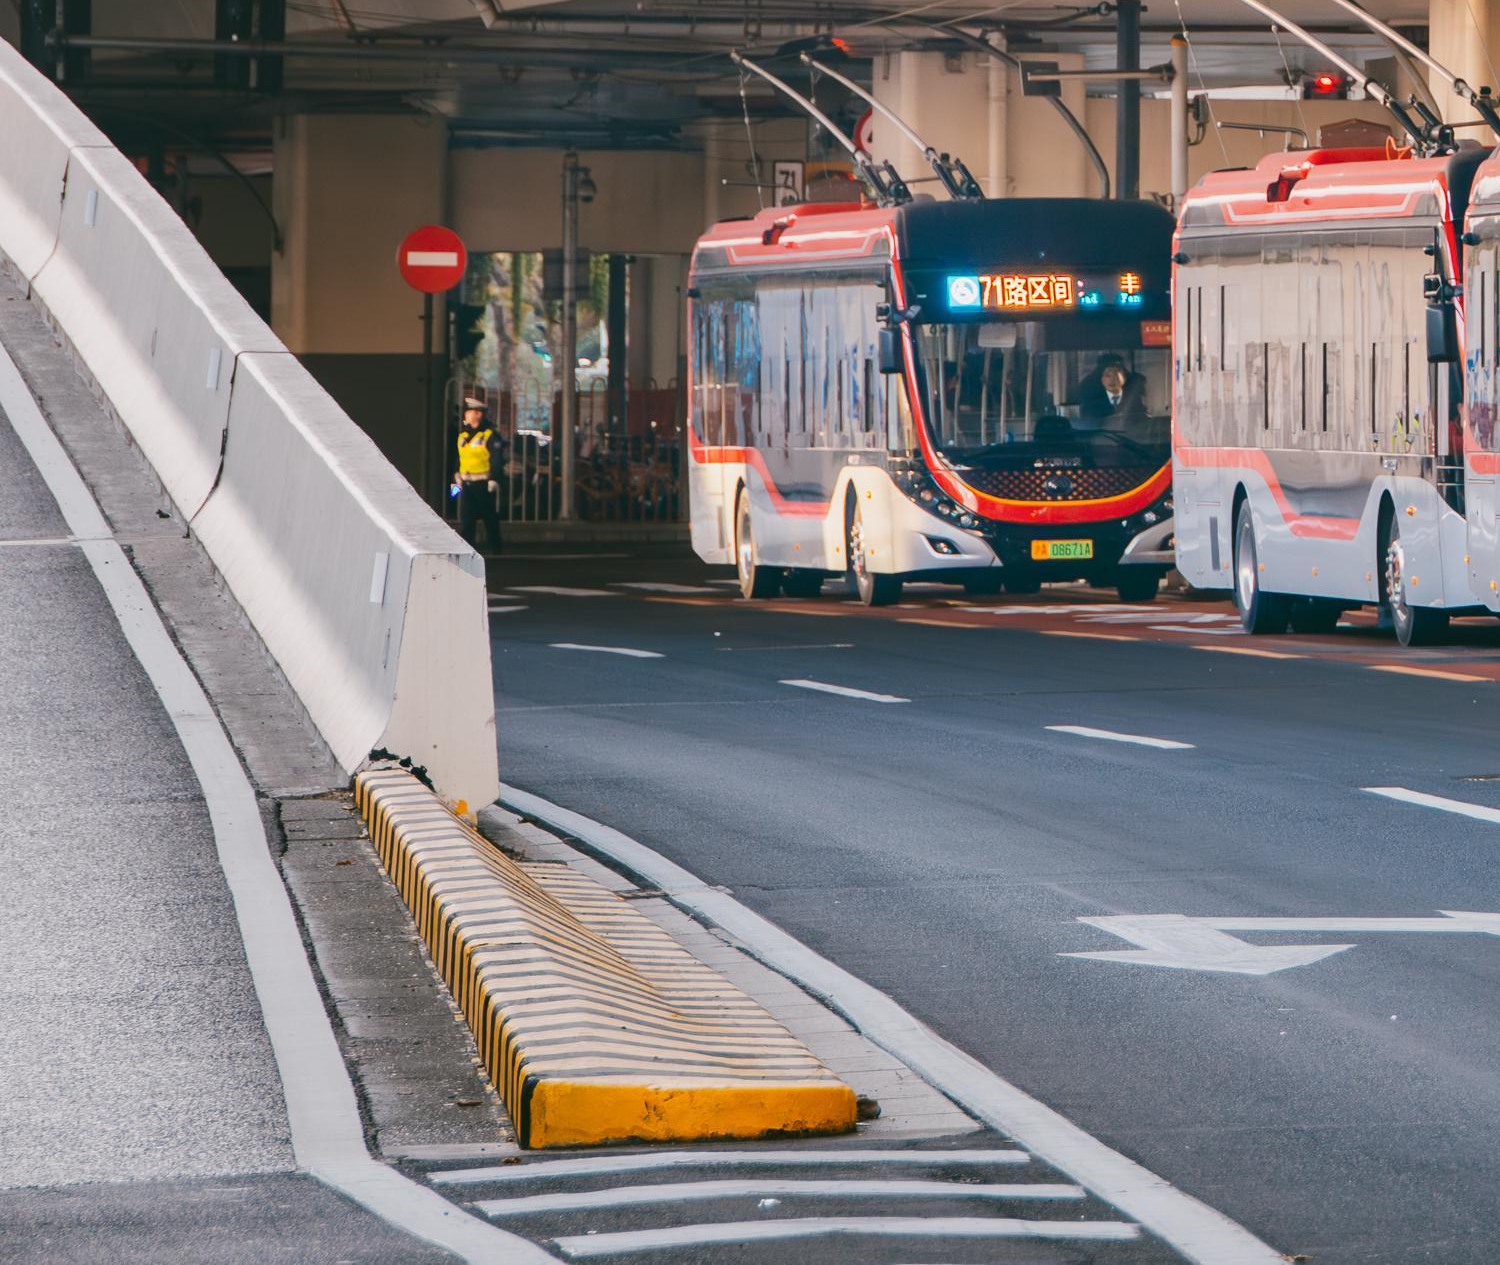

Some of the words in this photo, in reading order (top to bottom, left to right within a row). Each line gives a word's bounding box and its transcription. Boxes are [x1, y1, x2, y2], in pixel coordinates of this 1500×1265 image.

[780, 170, 796, 190] 71
[979, 276, 1073, 306] 71路区间
[1051, 543, 1091, 556] 08671A
